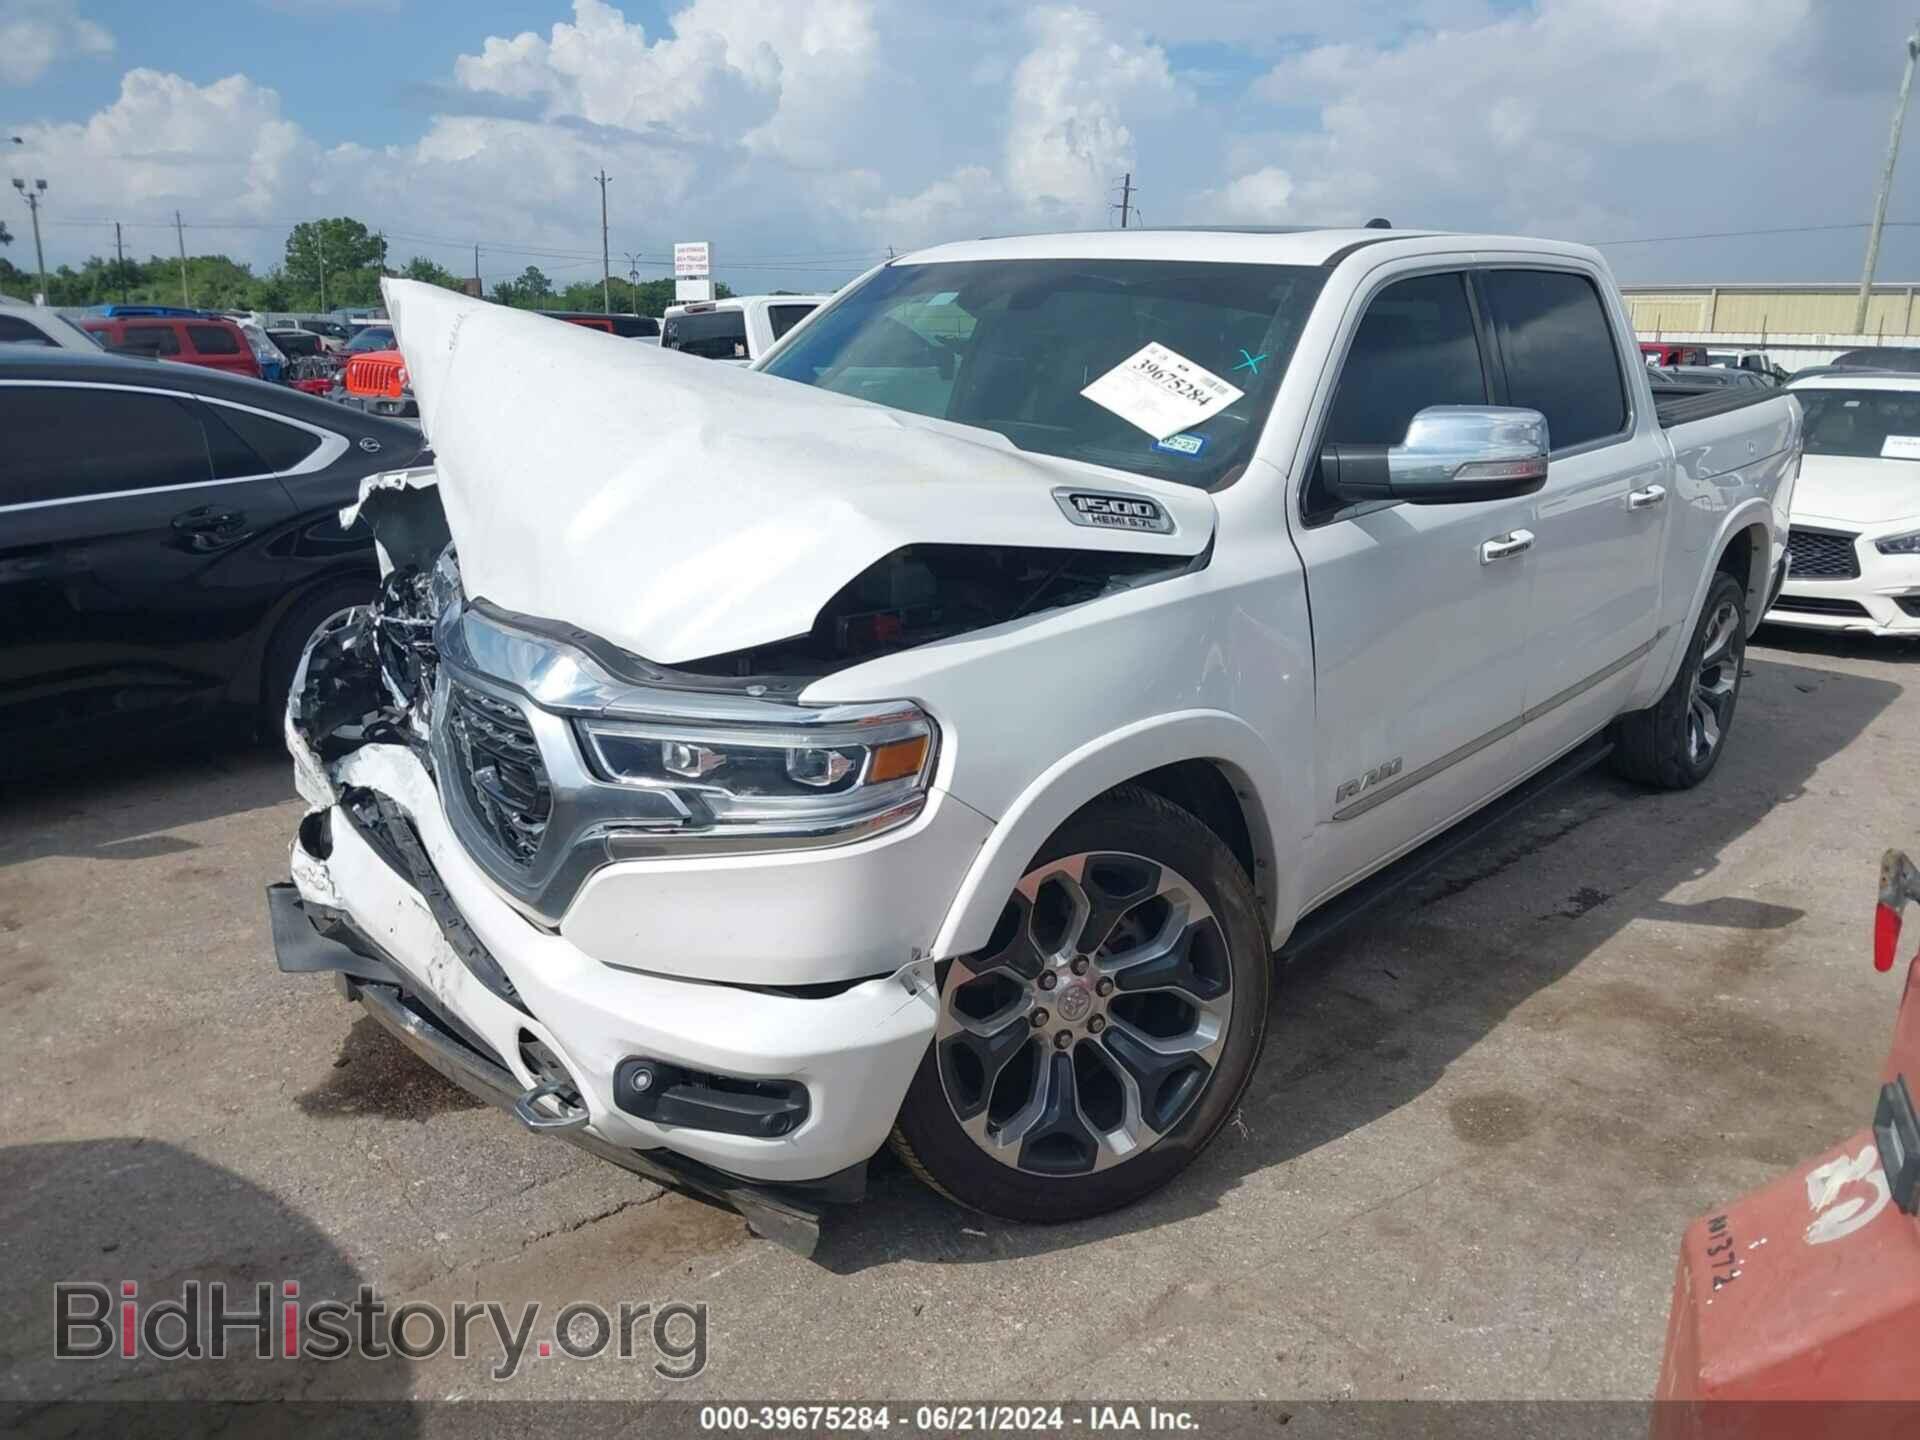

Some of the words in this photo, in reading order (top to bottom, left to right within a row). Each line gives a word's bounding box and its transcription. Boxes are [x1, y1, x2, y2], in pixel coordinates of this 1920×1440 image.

[1132, 358, 1213, 407] 39675284
[1073, 496, 1153, 517] 1500
[1090, 513, 1128, 525] HEMI
[1335, 755, 1403, 804] RAM
